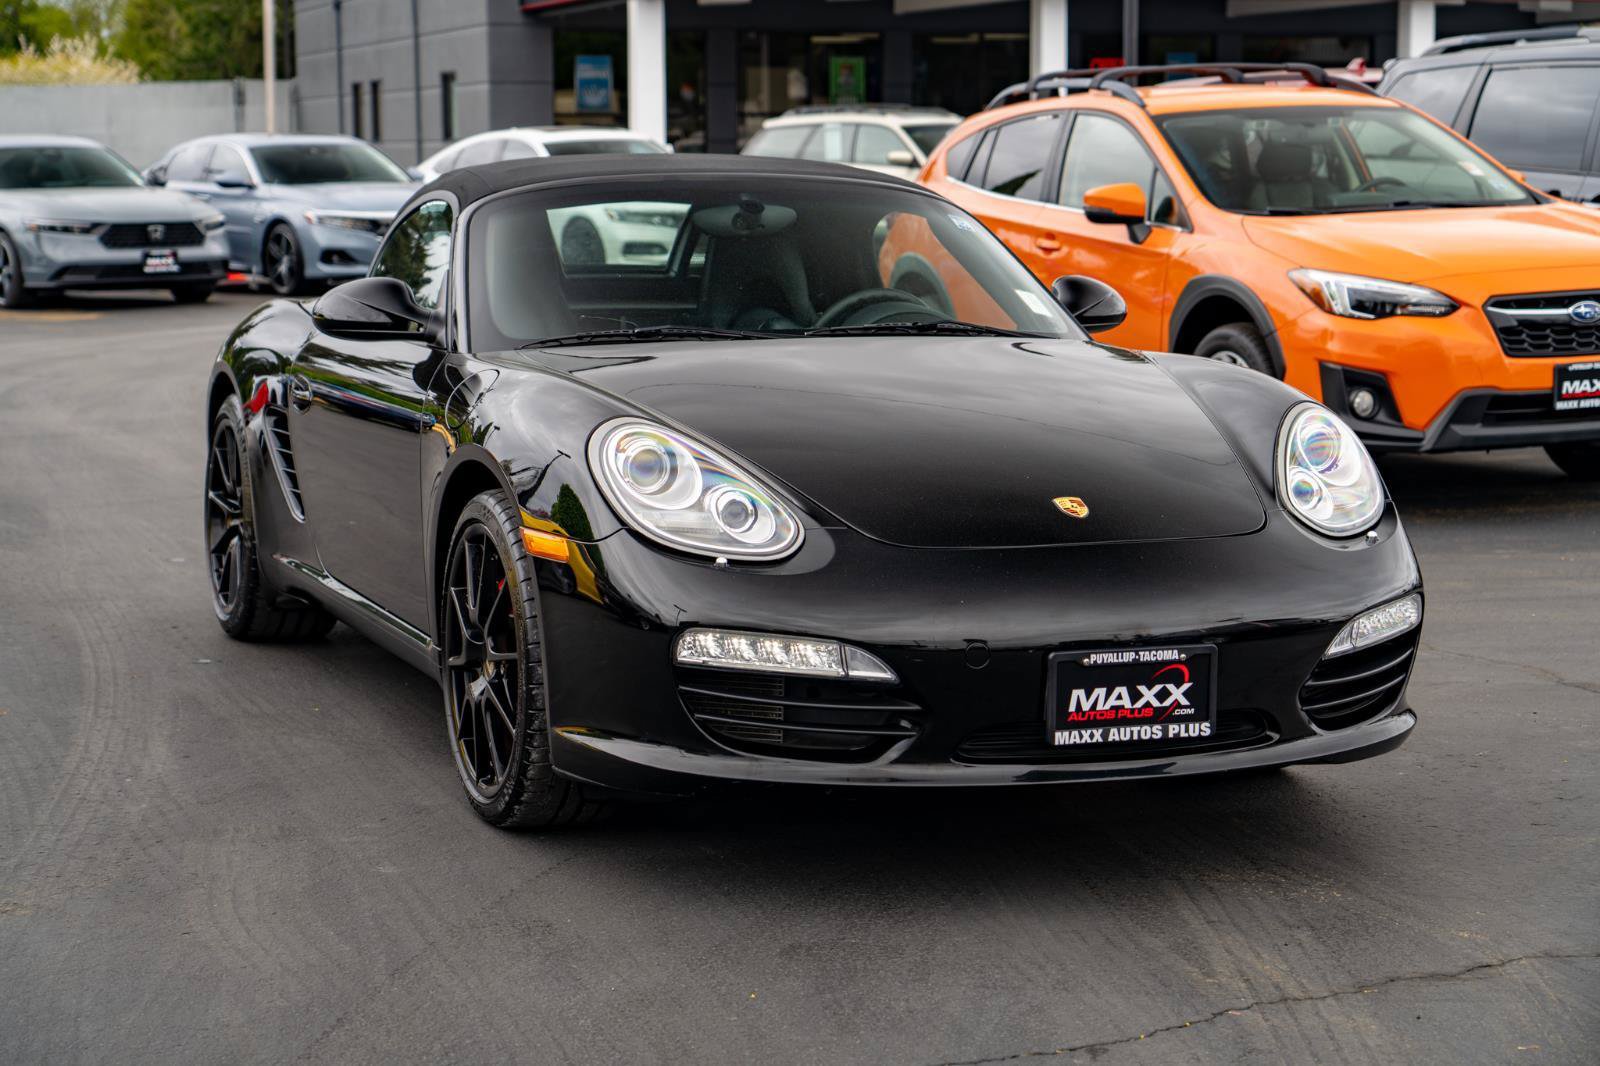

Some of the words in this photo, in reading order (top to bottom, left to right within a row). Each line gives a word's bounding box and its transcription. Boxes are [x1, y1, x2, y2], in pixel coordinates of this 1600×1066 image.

[1556, 400, 1579, 410] MAXX
[1068, 682, 1194, 712] MAXX
[1067, 709, 1115, 722] AUTOS
[1118, 707, 1154, 719] PLUS
[1172, 708, 1195, 716] .COM
[1054, 729, 1104, 746] MAXX
[1107, 725, 1163, 742] AUTOS
[1168, 722, 1211, 738] PLUS
